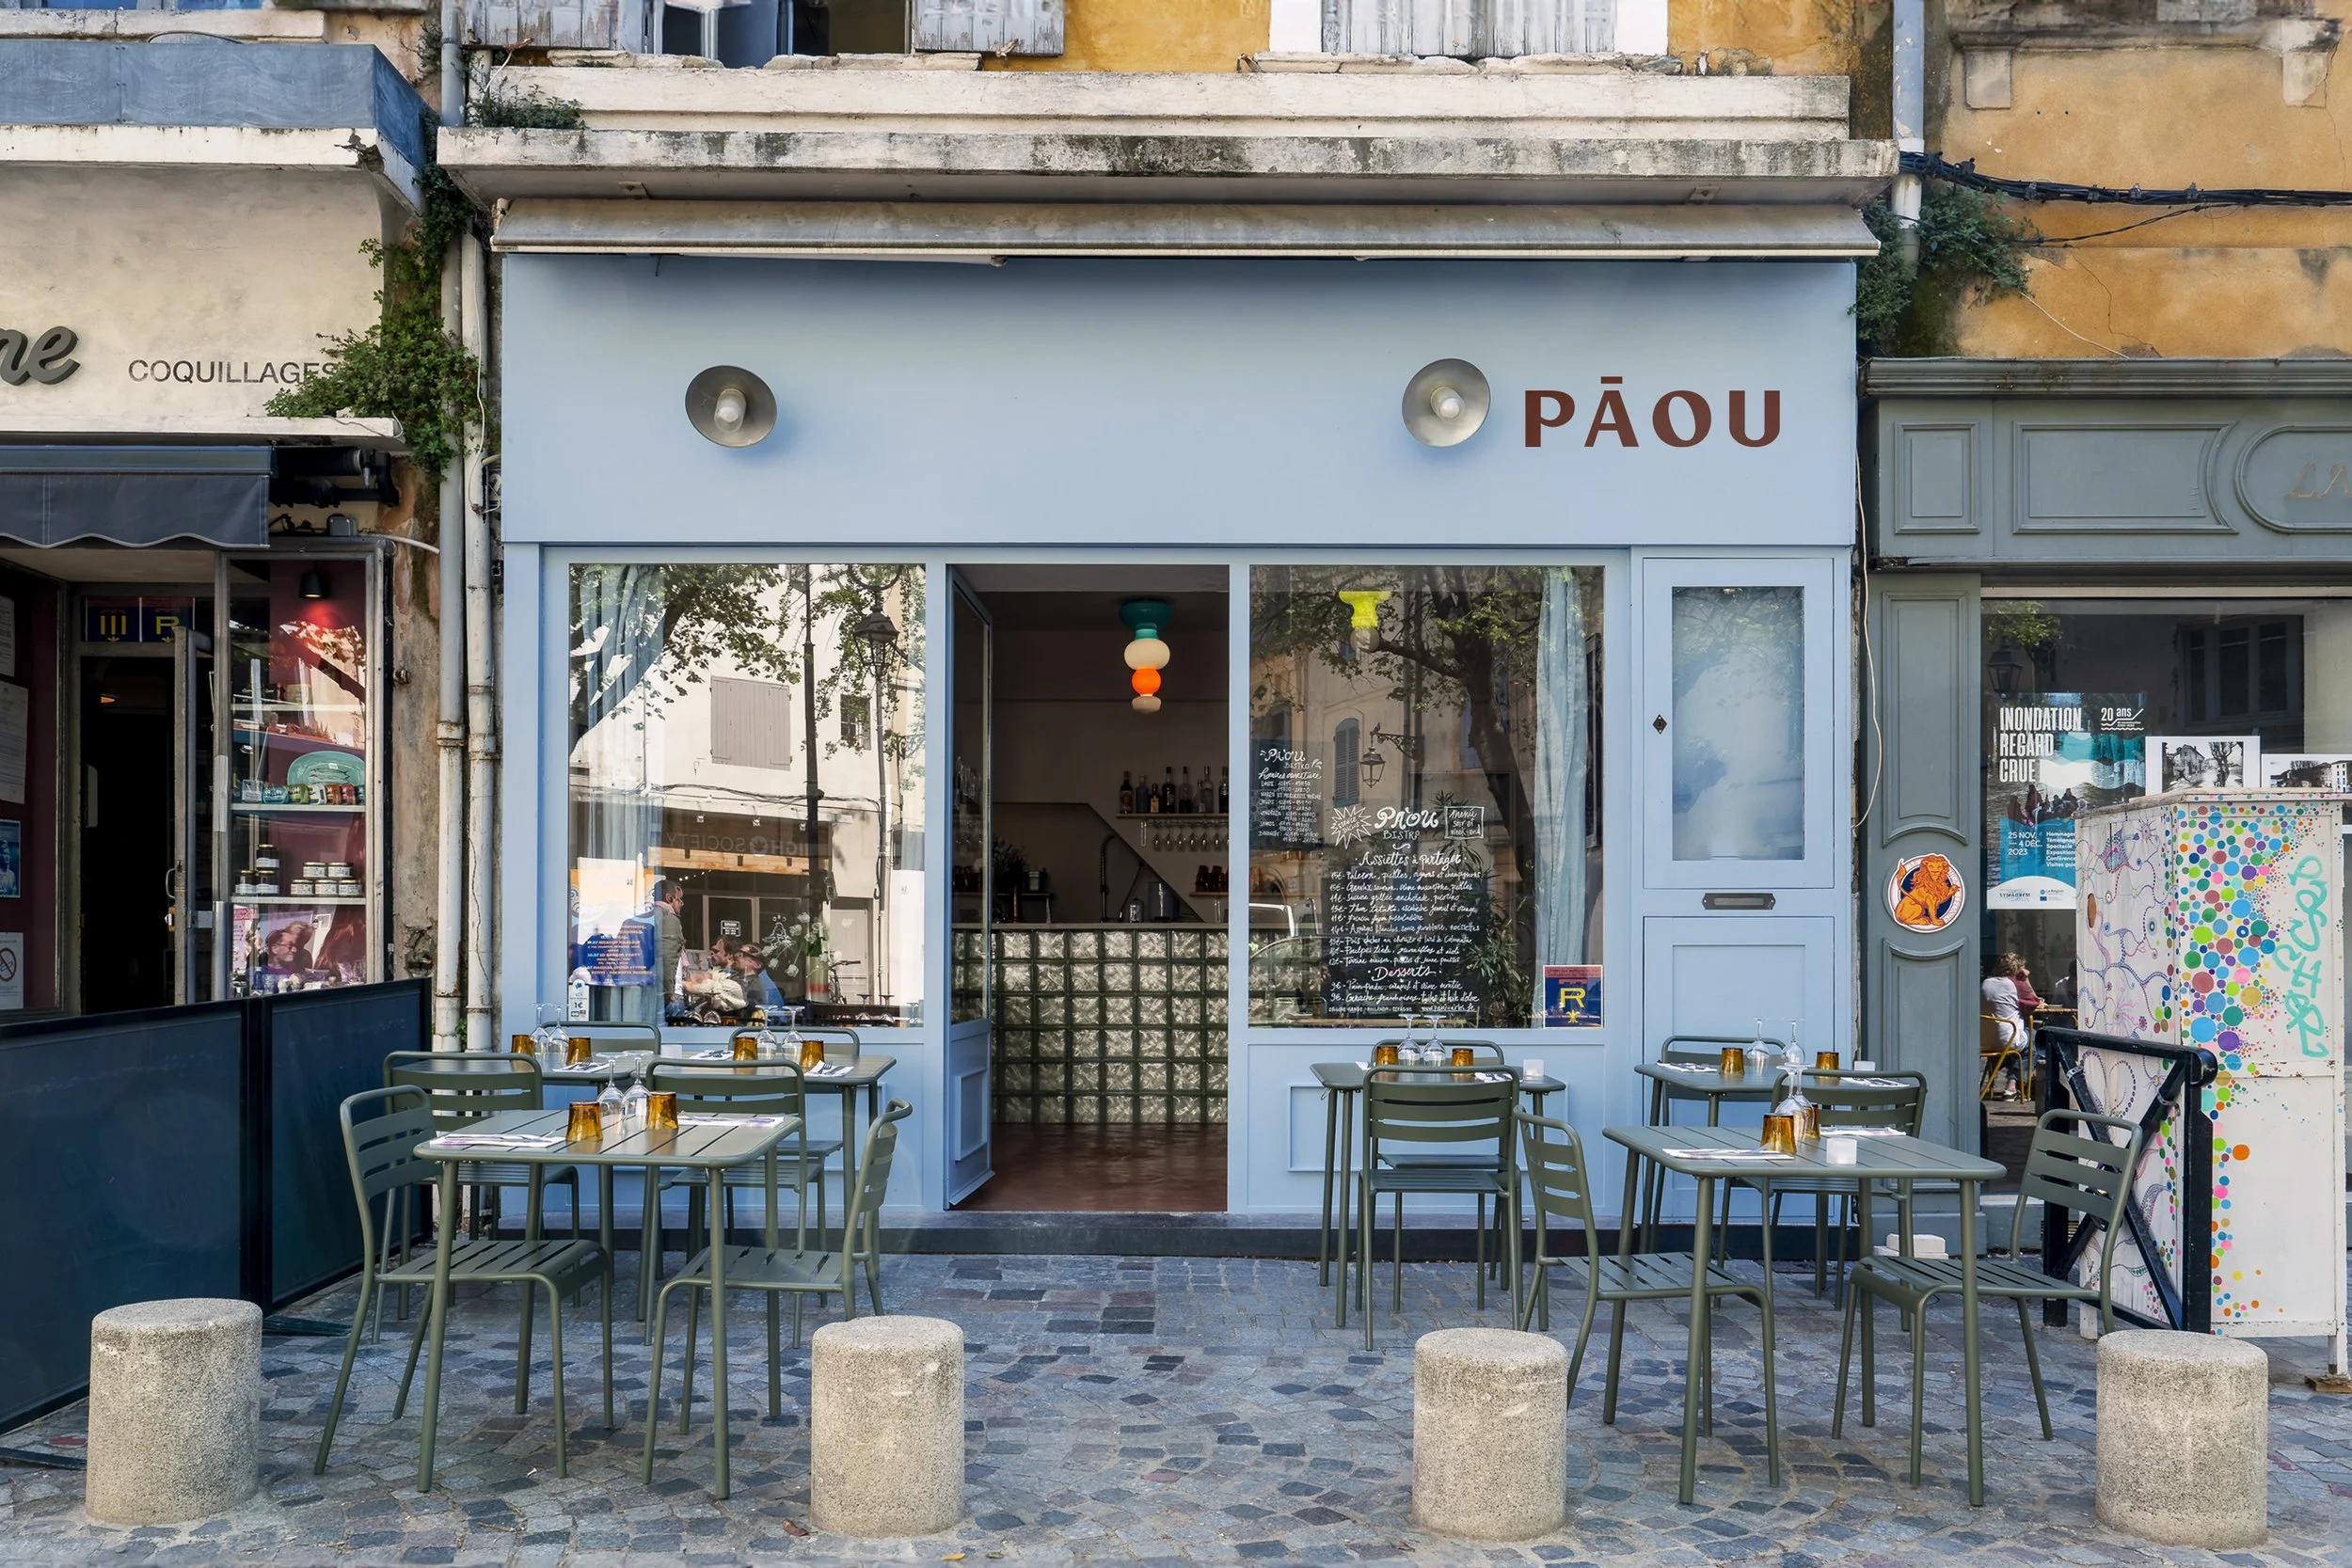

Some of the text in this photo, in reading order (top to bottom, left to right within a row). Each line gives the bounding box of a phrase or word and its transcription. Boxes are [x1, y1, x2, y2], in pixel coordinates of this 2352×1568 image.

[1999, 706, 2082, 731] INONDATION
[2101, 707, 2132, 721] 20 ans
[1999, 733, 2055, 757] REGARD
[1999, 758, 2036, 783] CRUE
[1383, 830, 1421, 840] BISTRO
[2025, 838, 2043, 847] DÉC.
[1359, 851, 1409, 866] Assiettes
[1412, 856, 1419, 864] à
[1371, 965, 1437, 982] Desserts
[1560, 988, 1586, 1008] R
